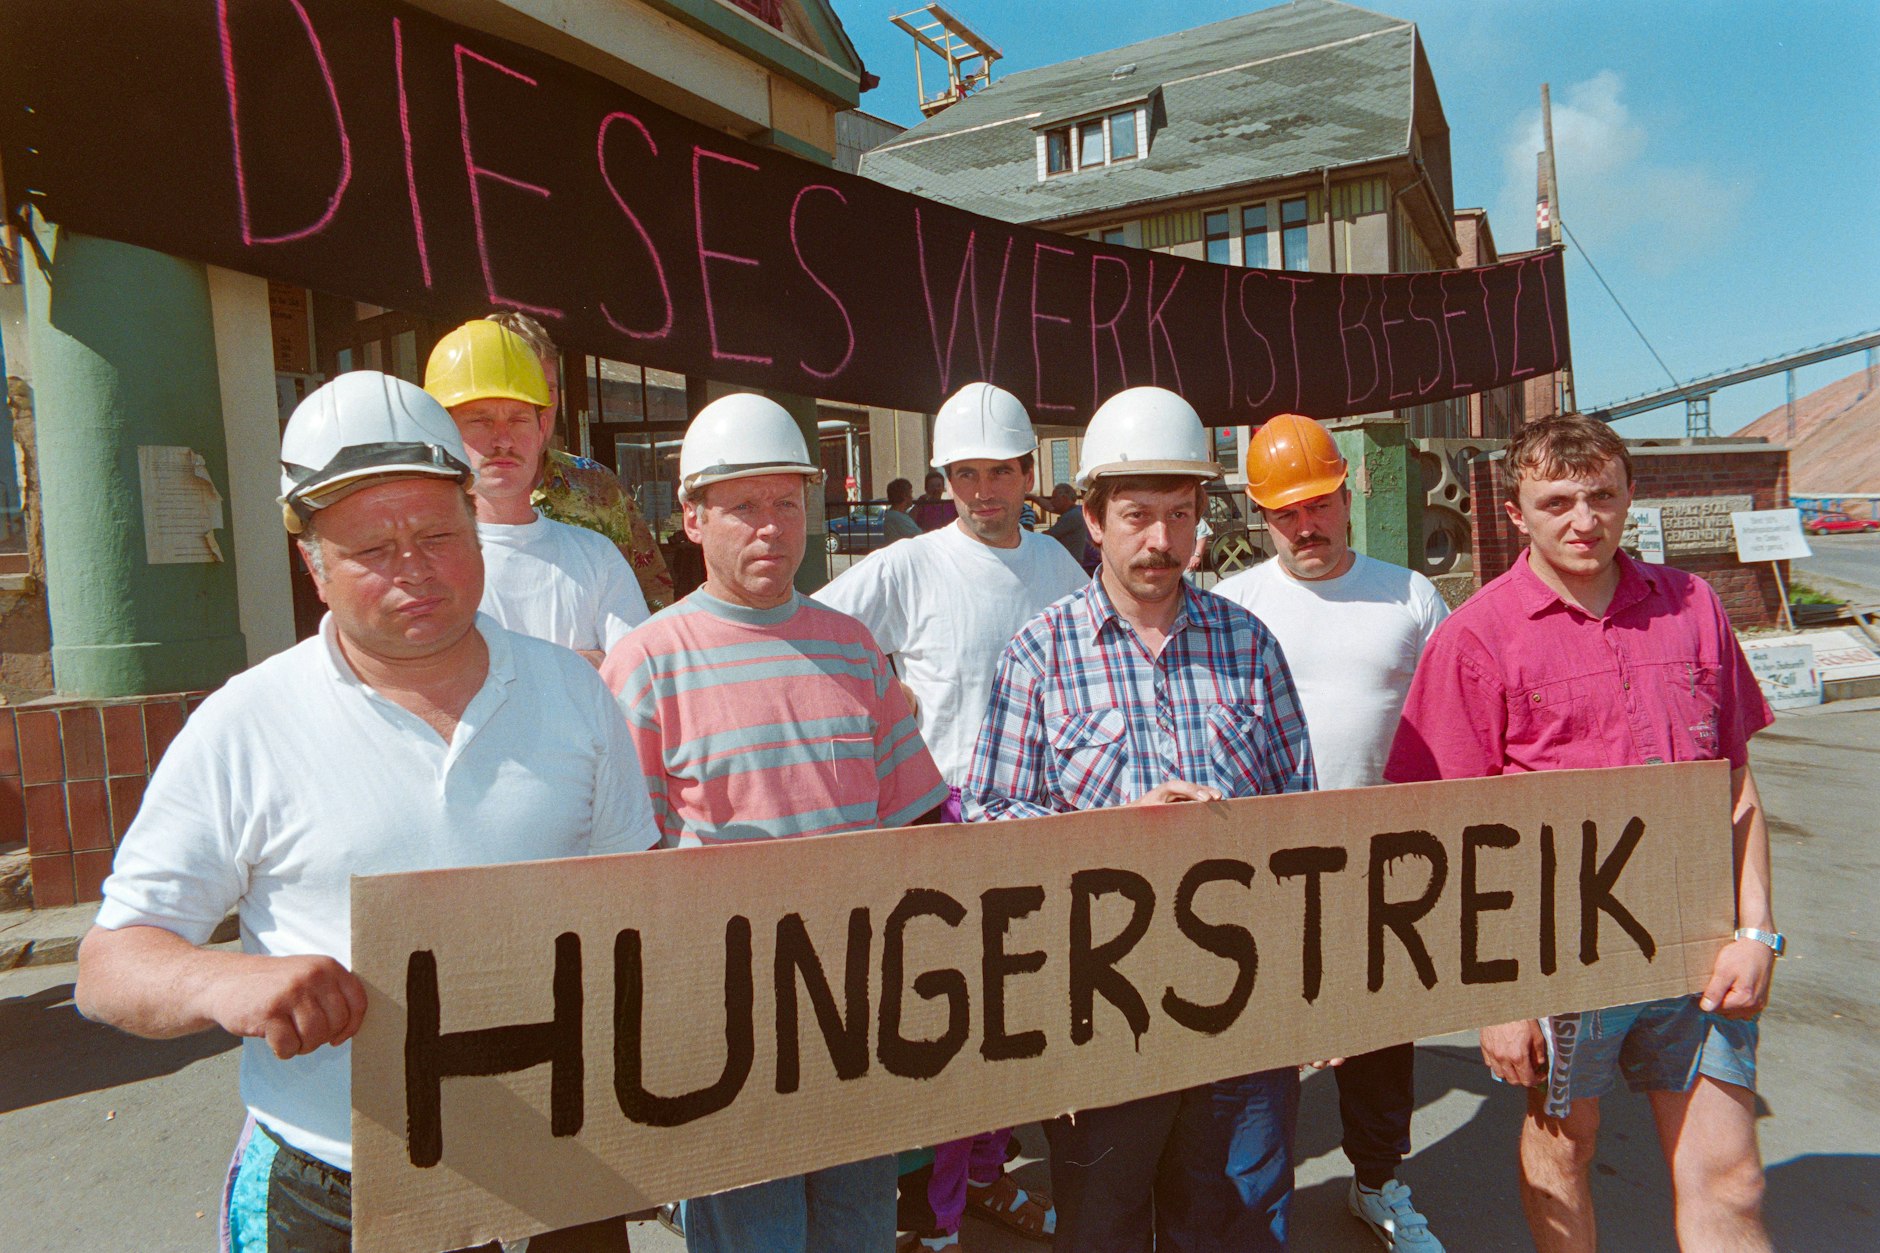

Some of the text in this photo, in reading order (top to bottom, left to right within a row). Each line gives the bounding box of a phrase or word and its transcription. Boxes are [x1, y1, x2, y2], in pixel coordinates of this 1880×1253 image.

[216, 0, 1559, 411] DIESES WERK IST BESETZT
[405, 815, 1656, 1168] HUNGERSTREIK
